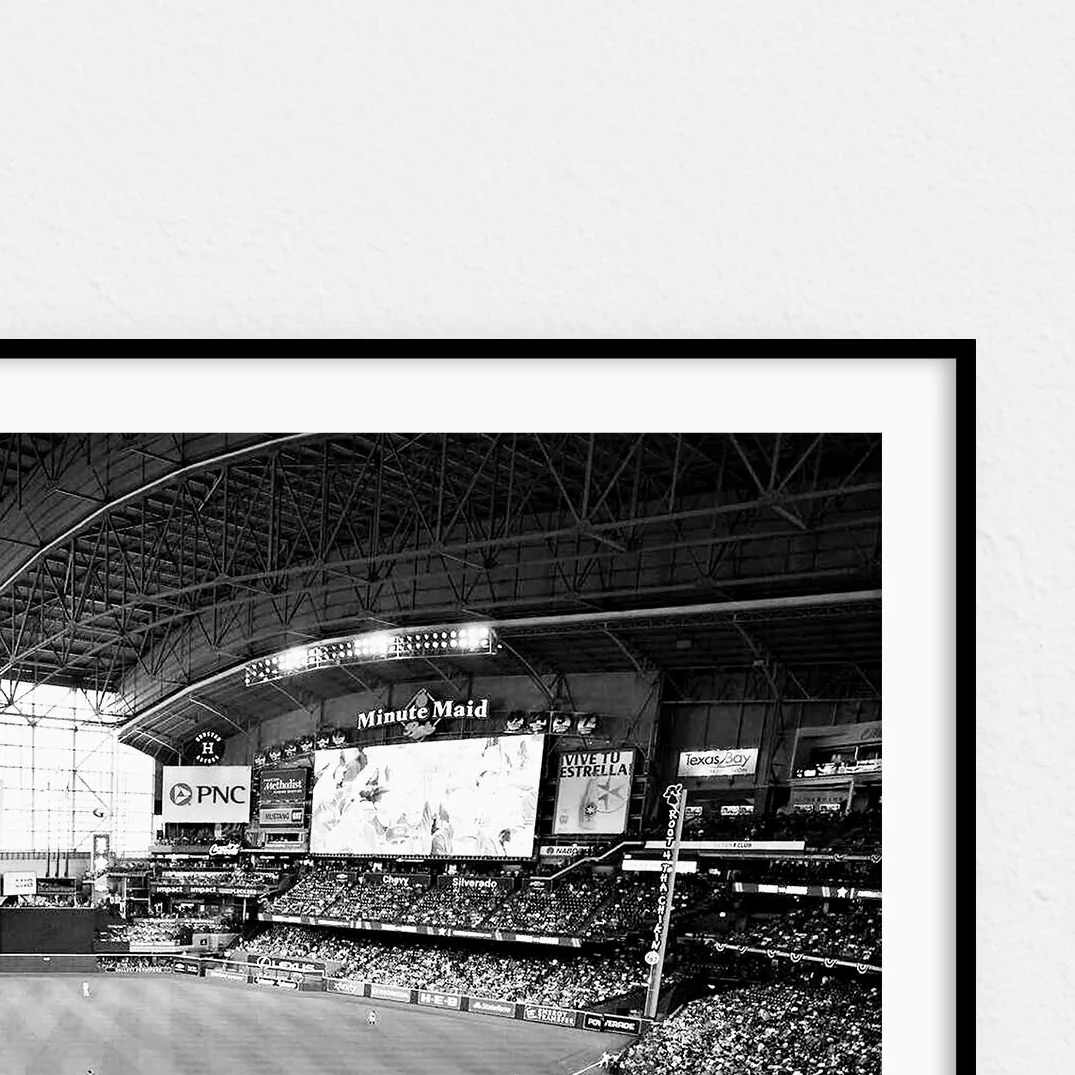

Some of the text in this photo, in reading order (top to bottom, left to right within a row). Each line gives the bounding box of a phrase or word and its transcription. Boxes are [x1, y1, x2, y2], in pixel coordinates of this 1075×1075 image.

[357, 699, 488, 730] Minute Maid
[202, 742, 214, 755] H
[599, 751, 620, 764] TU
[686, 753, 720, 766] Texas
[196, 785, 246, 804] PNC
[382, 875, 409, 886] Chevy
[452, 878, 498, 888] Silverado
[651, 896, 666, 949] CHIKIN
